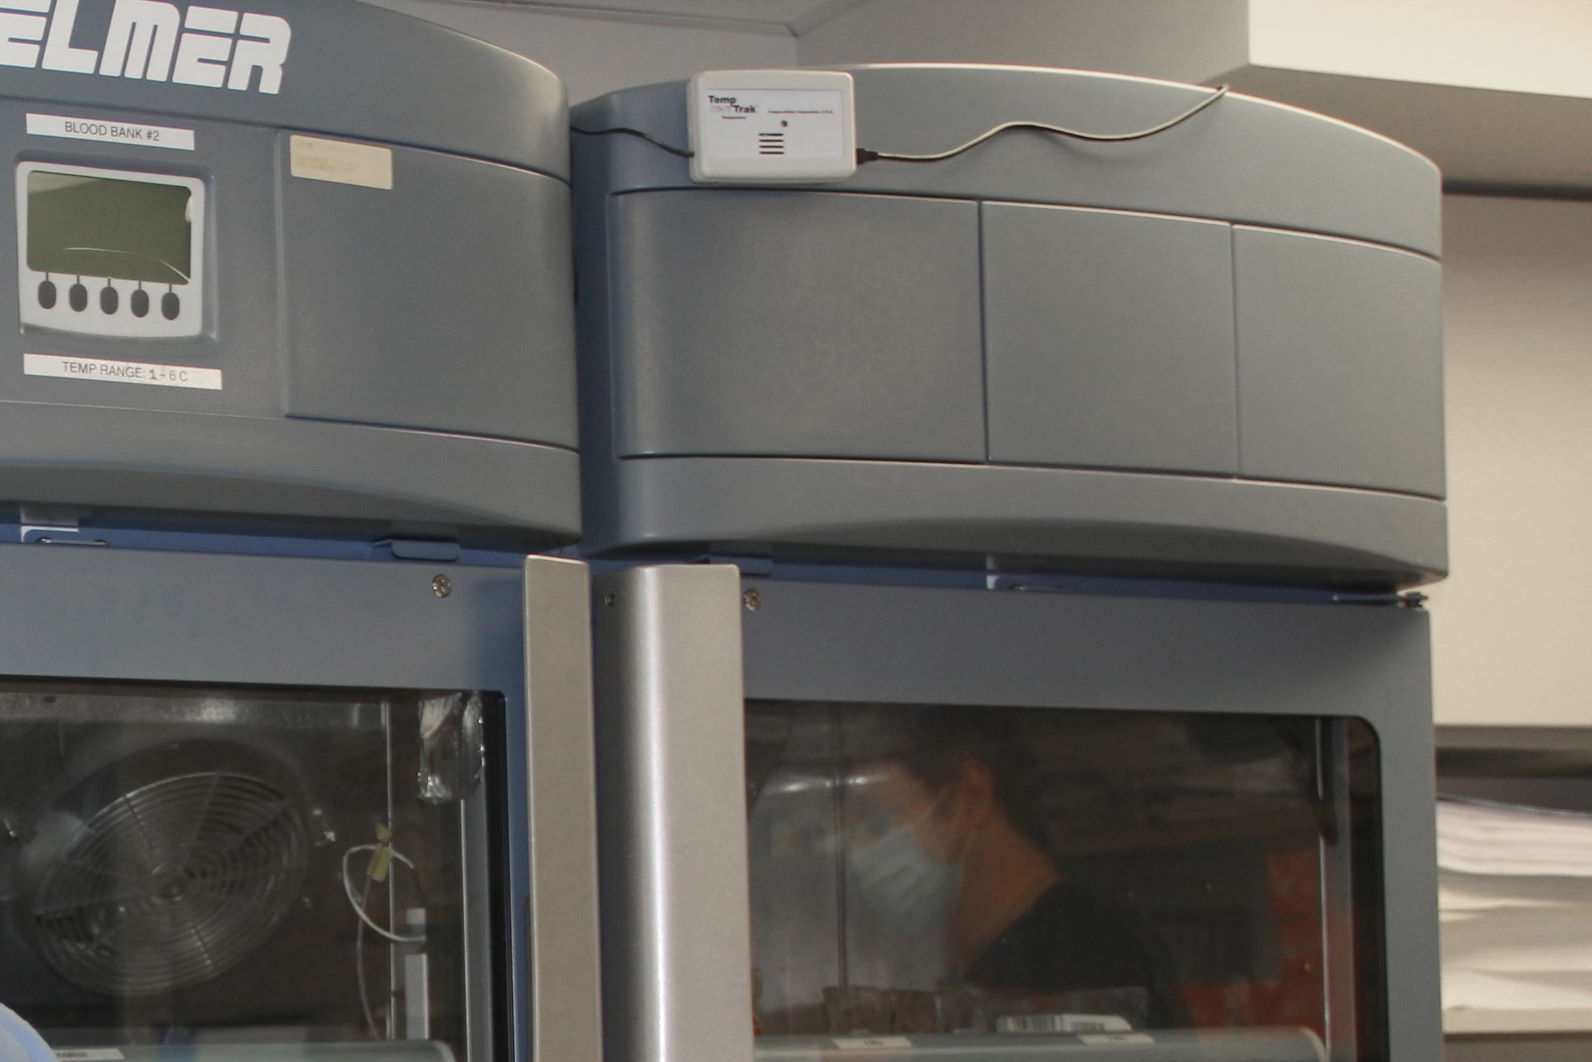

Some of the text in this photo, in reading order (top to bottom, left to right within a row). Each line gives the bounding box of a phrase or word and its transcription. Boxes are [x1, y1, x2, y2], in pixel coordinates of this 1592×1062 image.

[708, 95, 736, 106] Temp
[734, 105, 756, 113] Trak
[64, 121, 160, 141] BLOOD BANK #2
[62, 361, 97, 375] TEMP
[149, 369, 157, 380] 1
[168, 370, 176, 381] 6
[178, 371, 188, 382] C
